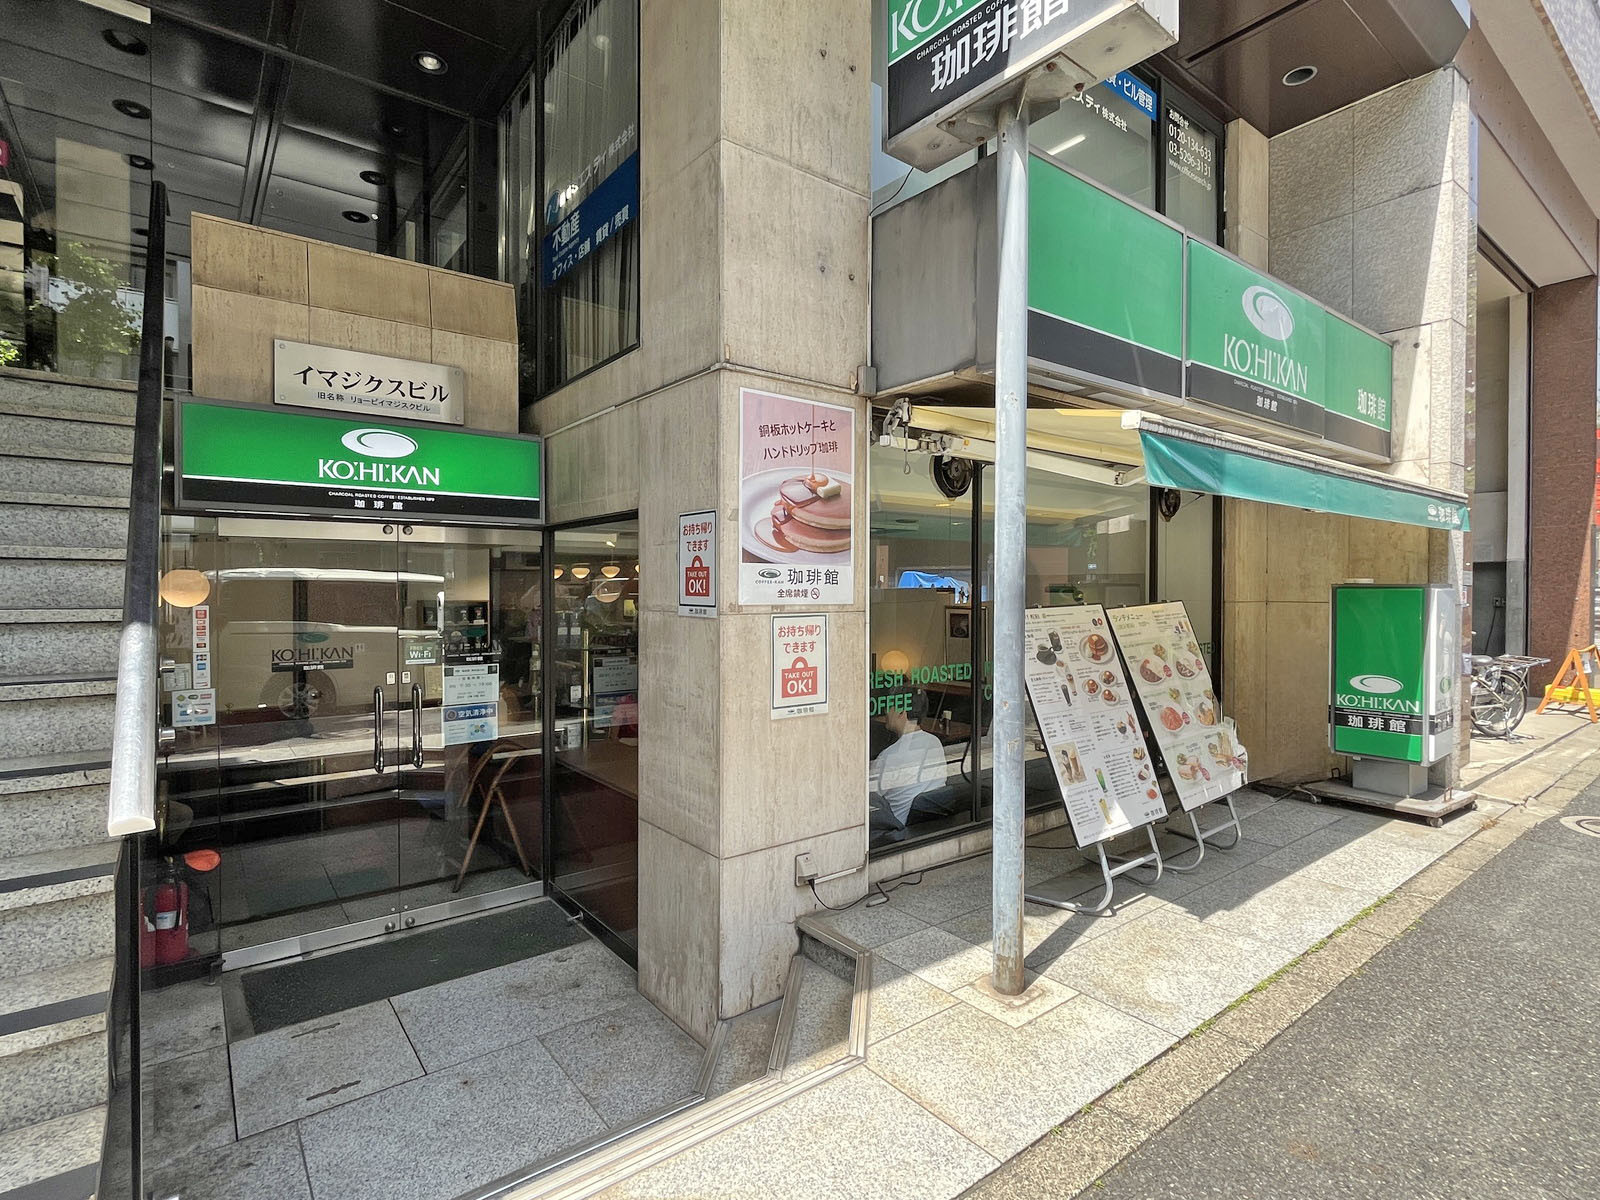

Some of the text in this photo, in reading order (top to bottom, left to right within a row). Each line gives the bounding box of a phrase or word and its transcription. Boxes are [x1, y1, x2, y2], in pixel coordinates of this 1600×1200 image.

[916, 0, 1007, 61] CHARCOAL ROASTED COFF
[1101, 106, 1128, 132] 株式会社
[1168, 124, 1212, 162] 0120-134-633
[1168, 141, 1211, 177] 03-5296-3131
[552, 210, 580, 251] 不動産
[293, 365, 449, 403] イマジクスビル
[317, 391, 345, 402] 旧名称
[1256, 396, 1278, 412] 珈琲館
[1357, 388, 1387, 421] 珈琲館
[759, 420, 837, 437] 銅板ホットケーキと
[764, 441, 838, 460] ハンドドリップ珈琲
[354, 499, 403, 510] 珈琲館
[683, 522, 713, 536] お持ち帰り
[686, 539, 709, 552] できます
[787, 568, 839, 585] 珈琲館
[688, 579, 706, 594] OK!
[777, 588, 809, 598] 全席禁煙
[777, 624, 821, 638] お持ち帰り
[409, 650, 432, 659] Wi-Fi
[783, 641, 816, 654] できます
[787, 679, 812, 694] OK!
[1348, 715, 1406, 733] 珈琲館
